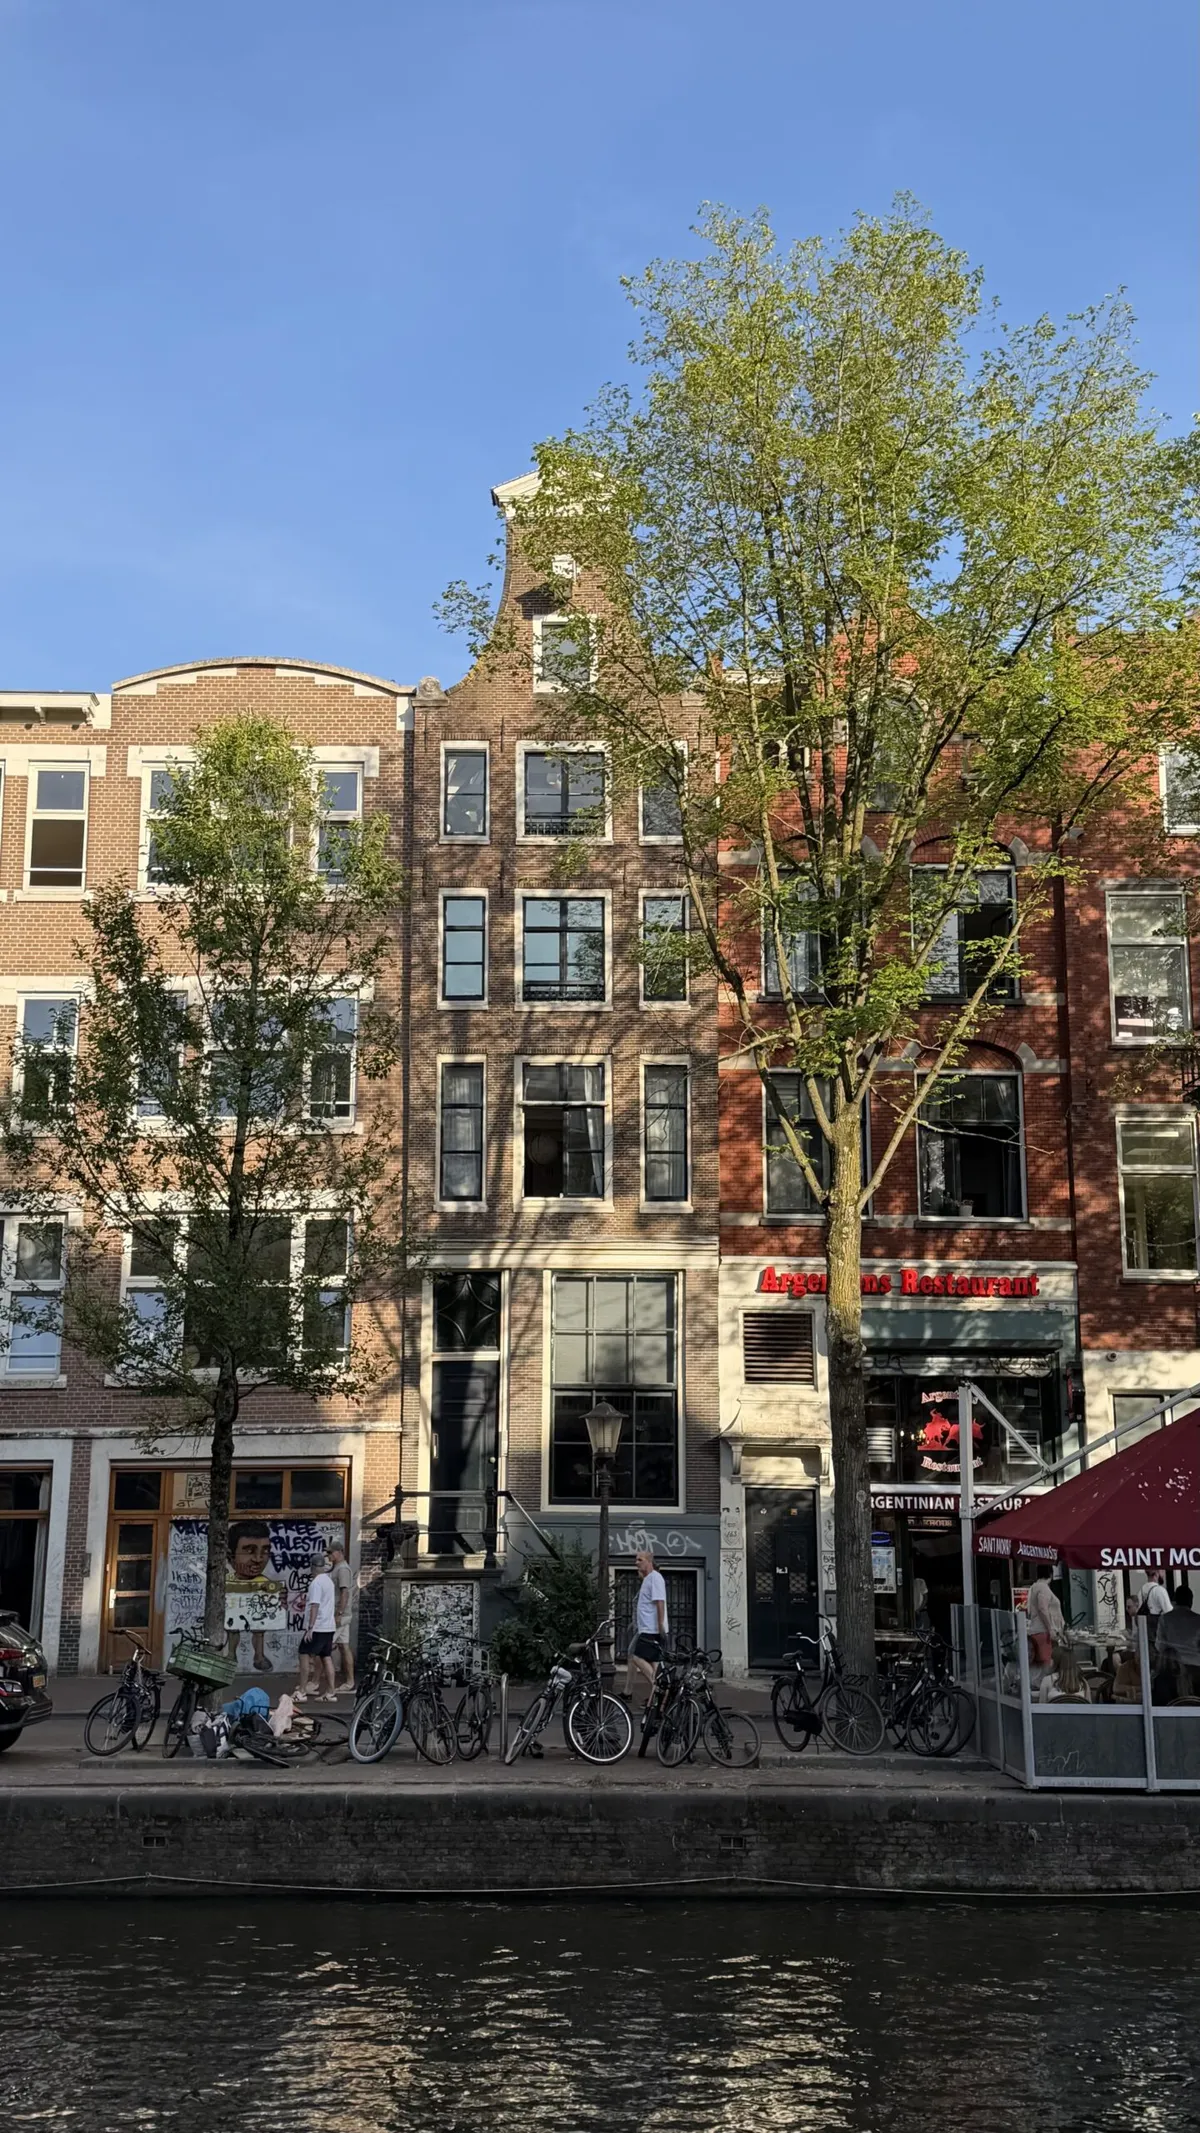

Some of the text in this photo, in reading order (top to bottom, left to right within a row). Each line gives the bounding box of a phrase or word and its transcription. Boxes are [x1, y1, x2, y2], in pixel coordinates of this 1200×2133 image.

[760, 1266, 1040, 1296] Argens Restaurant
[871, 1495, 955, 1510] RGENTINIAN
[1101, 1547, 1164, 1567] SAINT
